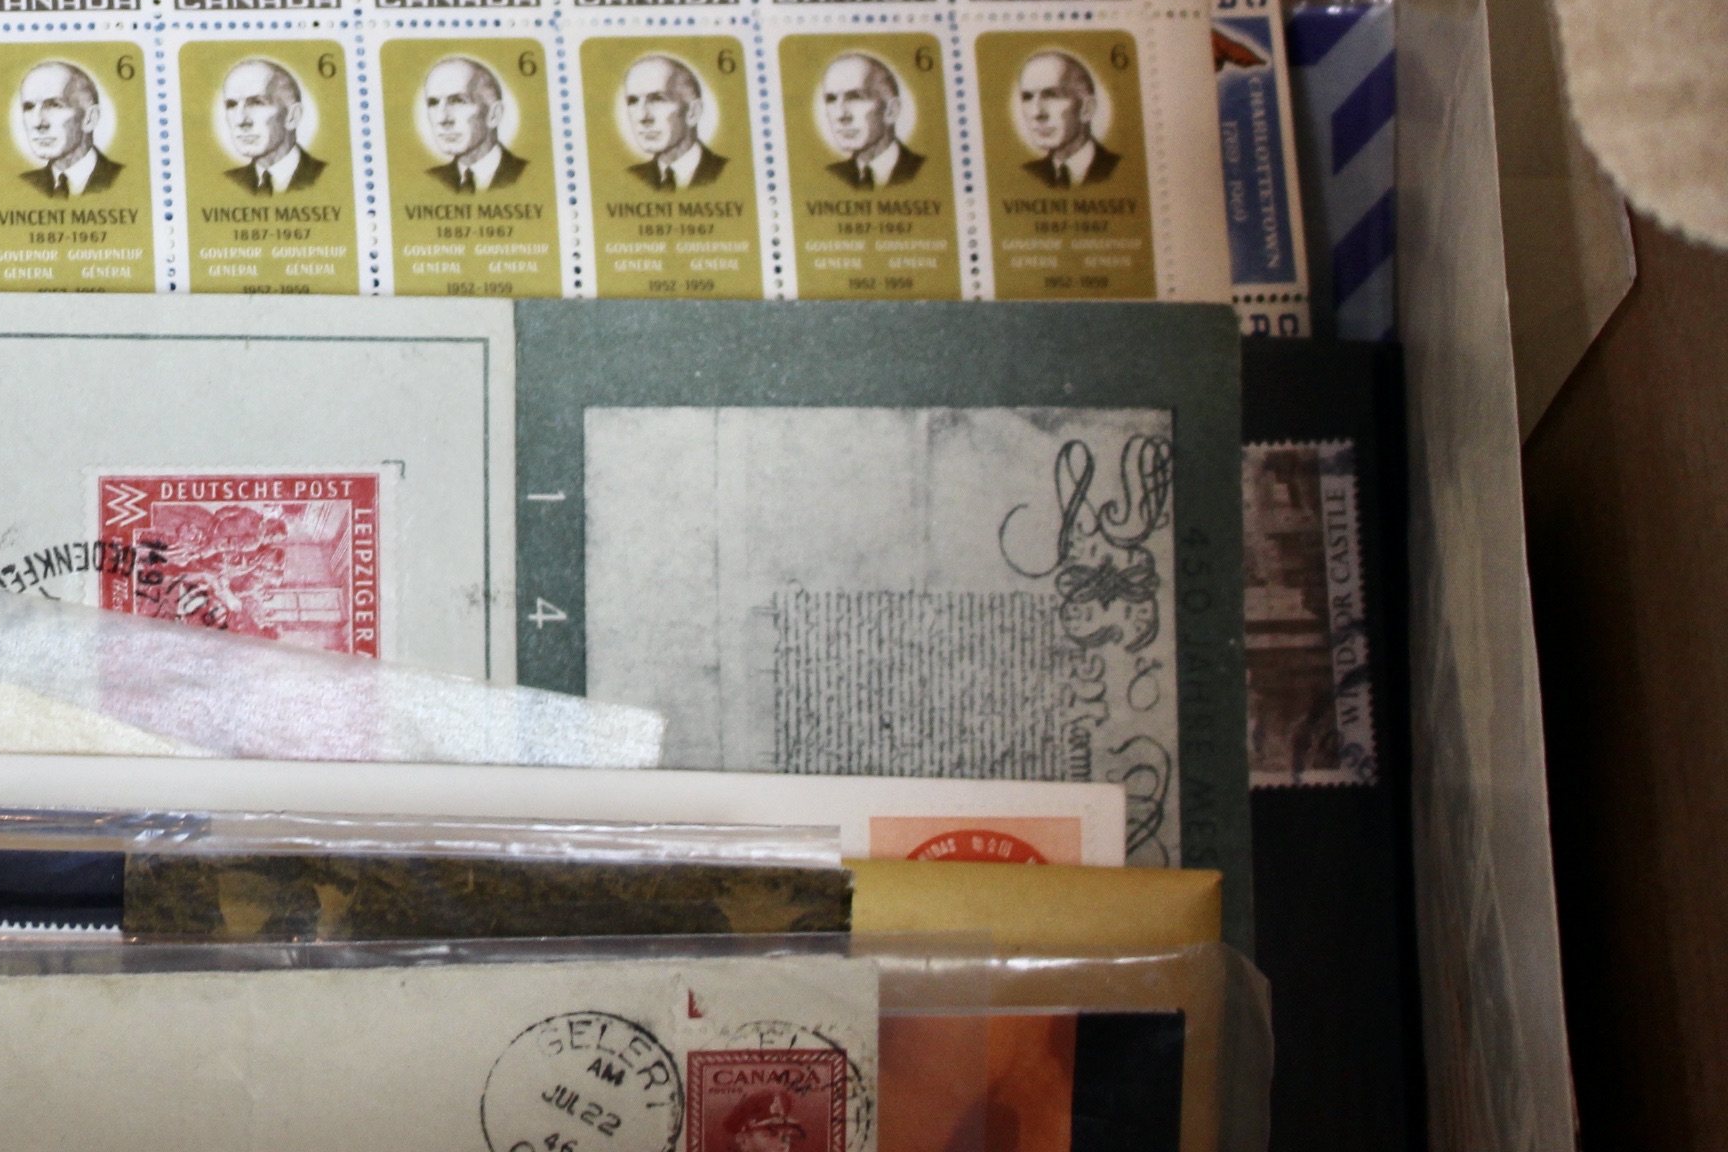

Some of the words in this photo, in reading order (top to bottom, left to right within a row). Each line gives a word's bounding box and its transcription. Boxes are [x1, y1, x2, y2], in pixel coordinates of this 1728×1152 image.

[114, 54, 135, 80] 6
[316, 52, 337, 78] 6
[516, 50, 537, 77] 6
[715, 48, 736, 75] 6
[912, 46, 933, 72] 6
[1108, 43, 1129, 70] 6
[70, 208, 138, 225] MASSEY
[201, 206, 269, 223] VINCENT
[274, 205, 342, 222] MASSEY
[404, 204, 472, 221] VINCENT
[476, 203, 544, 220] MASSEY
[160, 479, 283, 499] DEUTSCHE
[294, 479, 354, 499] POST
[1325, 488, 1351, 585] CASTLE
[353, 506, 375, 643] LEIPZIGER
[527, 596, 568, 630] 4
[587, 1059, 626, 1088] AM
[712, 1068, 821, 1086] CANADA
[541, 1084, 578, 1117] JUL
[579, 1101, 623, 1139] 22
